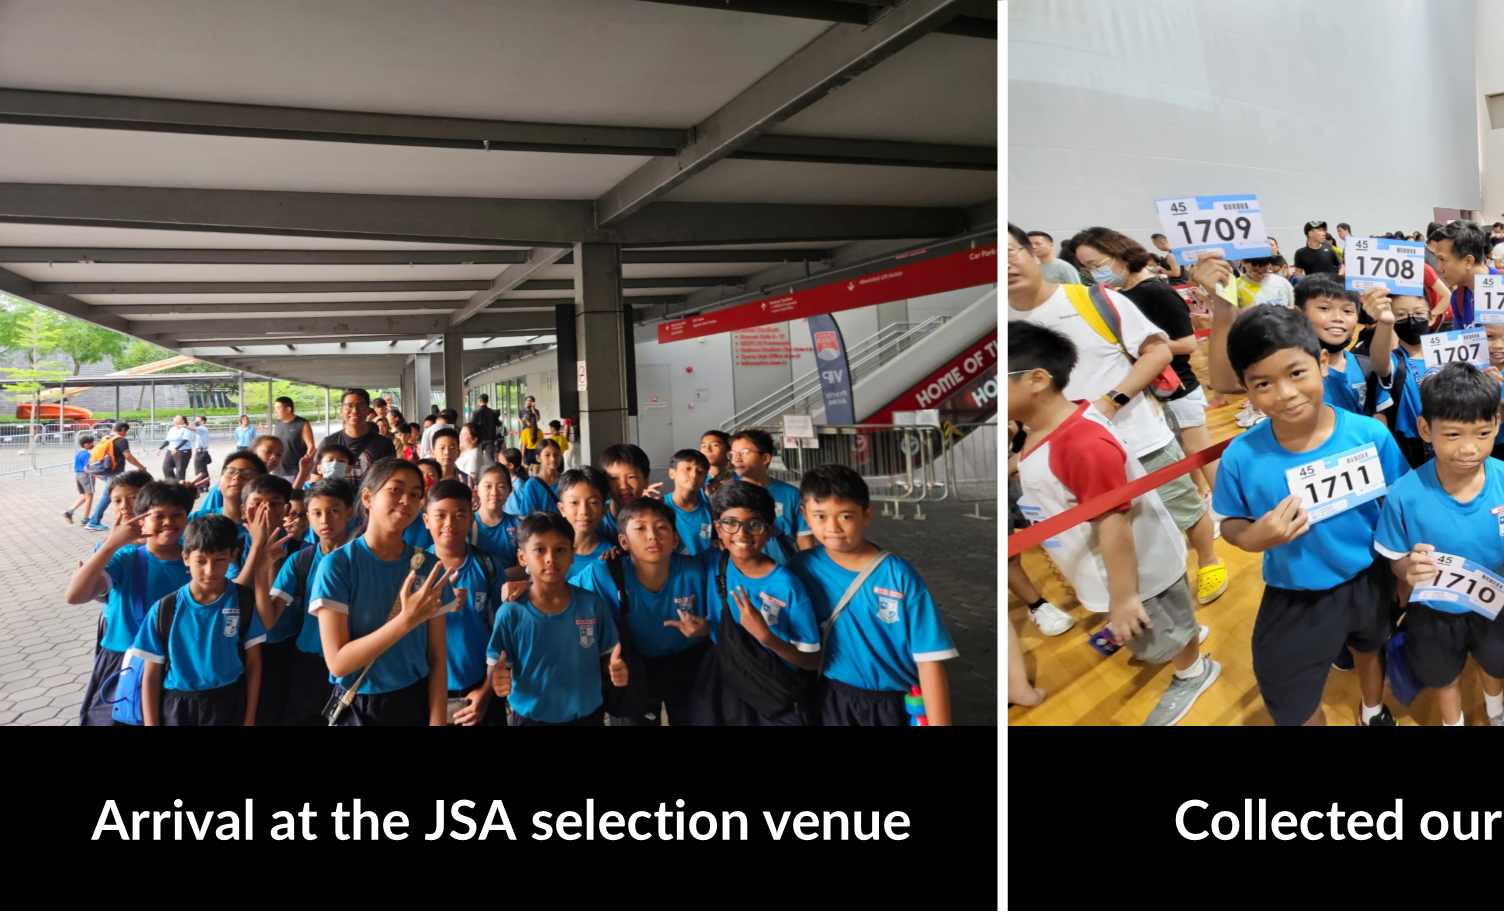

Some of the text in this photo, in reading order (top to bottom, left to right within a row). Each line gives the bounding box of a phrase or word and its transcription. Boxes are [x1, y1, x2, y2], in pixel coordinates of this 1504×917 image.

[1170, 202, 1187, 212] 45
[1177, 216, 1251, 245] 1709
[969, 252, 981, 260] Car
[1355, 240, 1369, 249] 45
[1356, 255, 1415, 280] 1708
[1433, 343, 1481, 365] 1707
[915, 340, 998, 408] HOME OF T
[971, 375, 998, 408] HO
[1299, 465, 1315, 477] 45
[1304, 465, 1370, 504] 1711
[1437, 555, 1453, 564] 45
[1432, 569, 1496, 604] 1710
